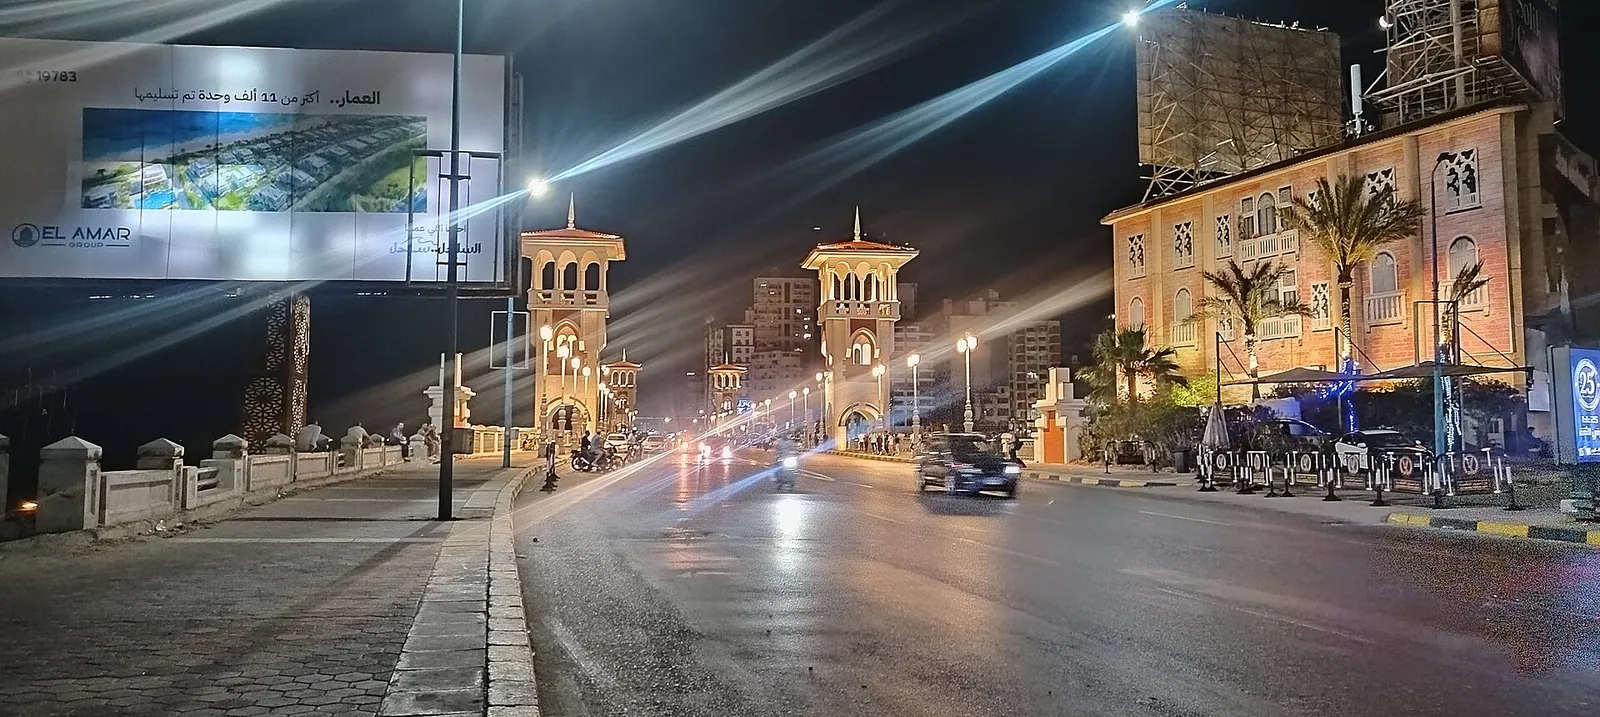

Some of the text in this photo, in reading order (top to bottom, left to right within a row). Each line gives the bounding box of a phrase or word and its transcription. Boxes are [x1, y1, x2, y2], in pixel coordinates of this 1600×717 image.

[36, 70, 77, 82] 19783
[134, 87, 178, 102] تسليمها
[182, 90, 196, 103] تم
[198, 90, 230, 104] وحدة
[234, 88, 257, 102] ألف
[261, 92, 278, 102] 11
[281, 94, 299, 106] من
[329, 89, 380, 107] العمار..
[42, 226, 131, 240] EL AMAR
[1579, 371, 1595, 395] 25
